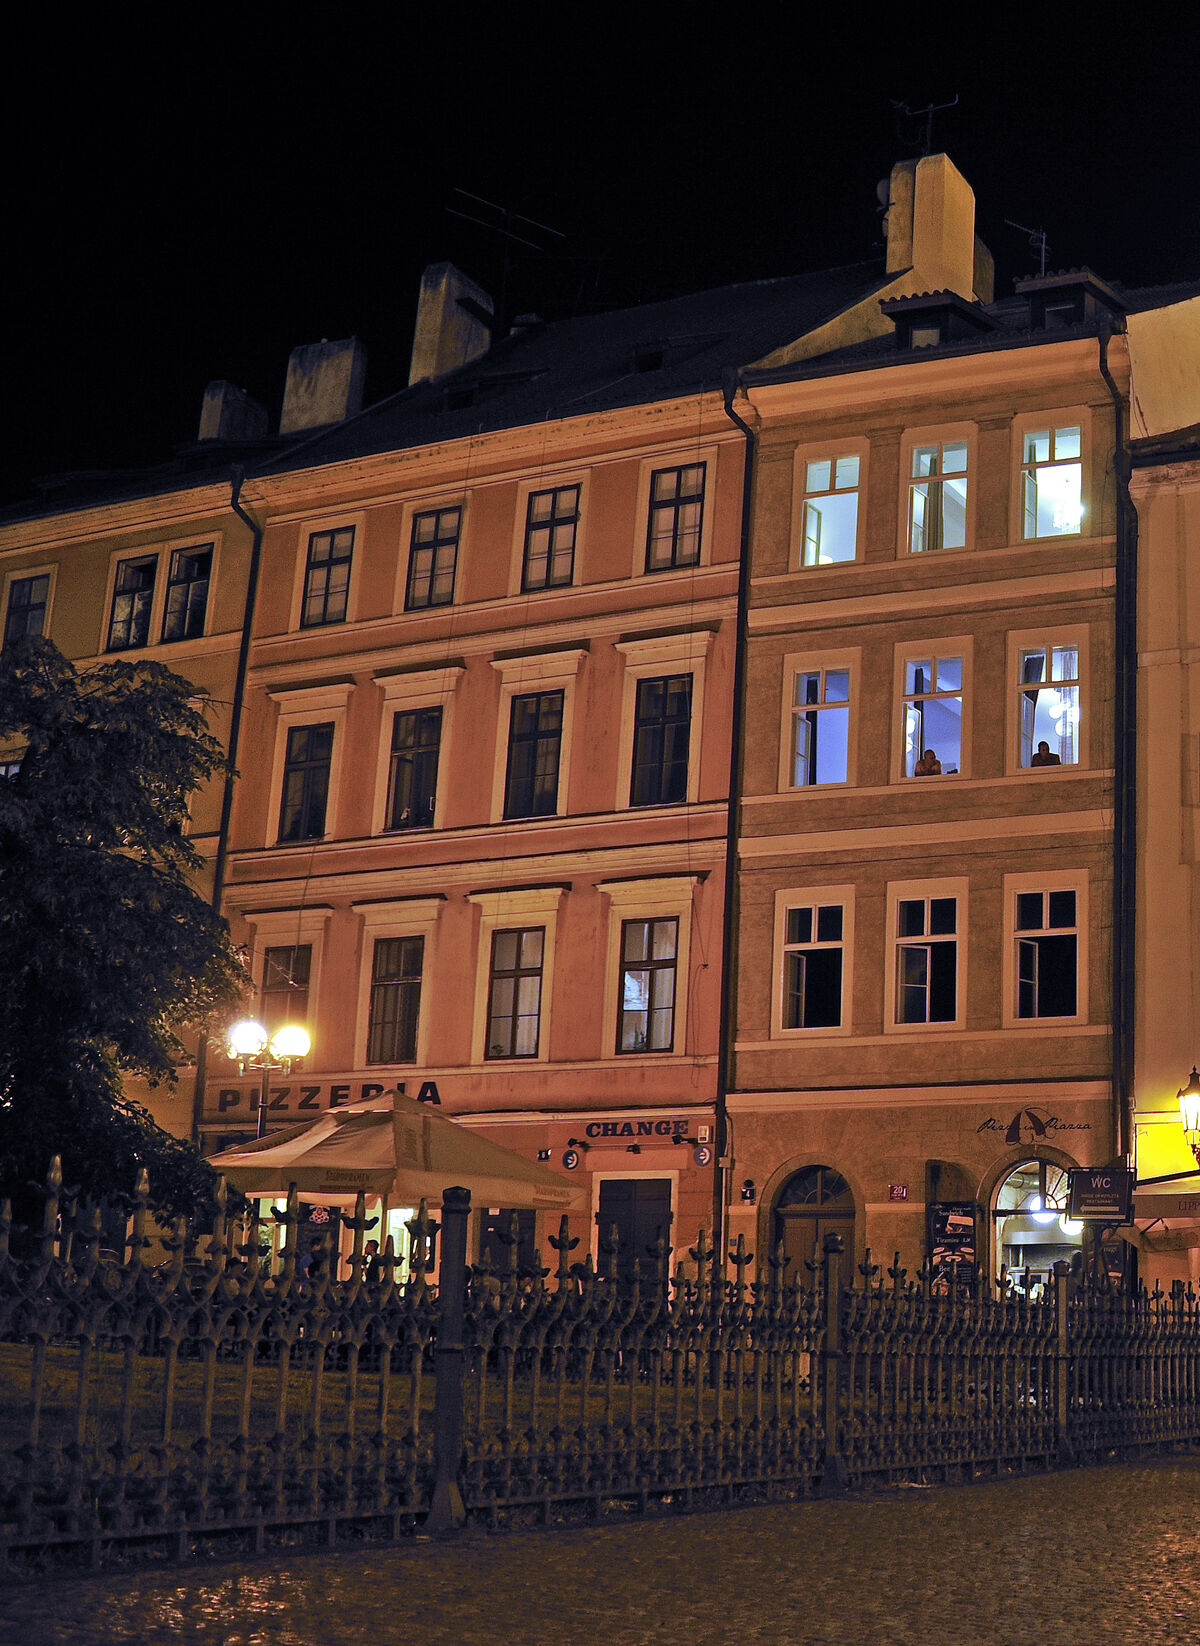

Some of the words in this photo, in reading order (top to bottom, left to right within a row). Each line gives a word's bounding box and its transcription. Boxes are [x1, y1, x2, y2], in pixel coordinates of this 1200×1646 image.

[586, 1120, 689, 1138] CHANGE
[1043, 1117, 1092, 1131] Piazza
[1091, 1176, 1111, 1188] WC
